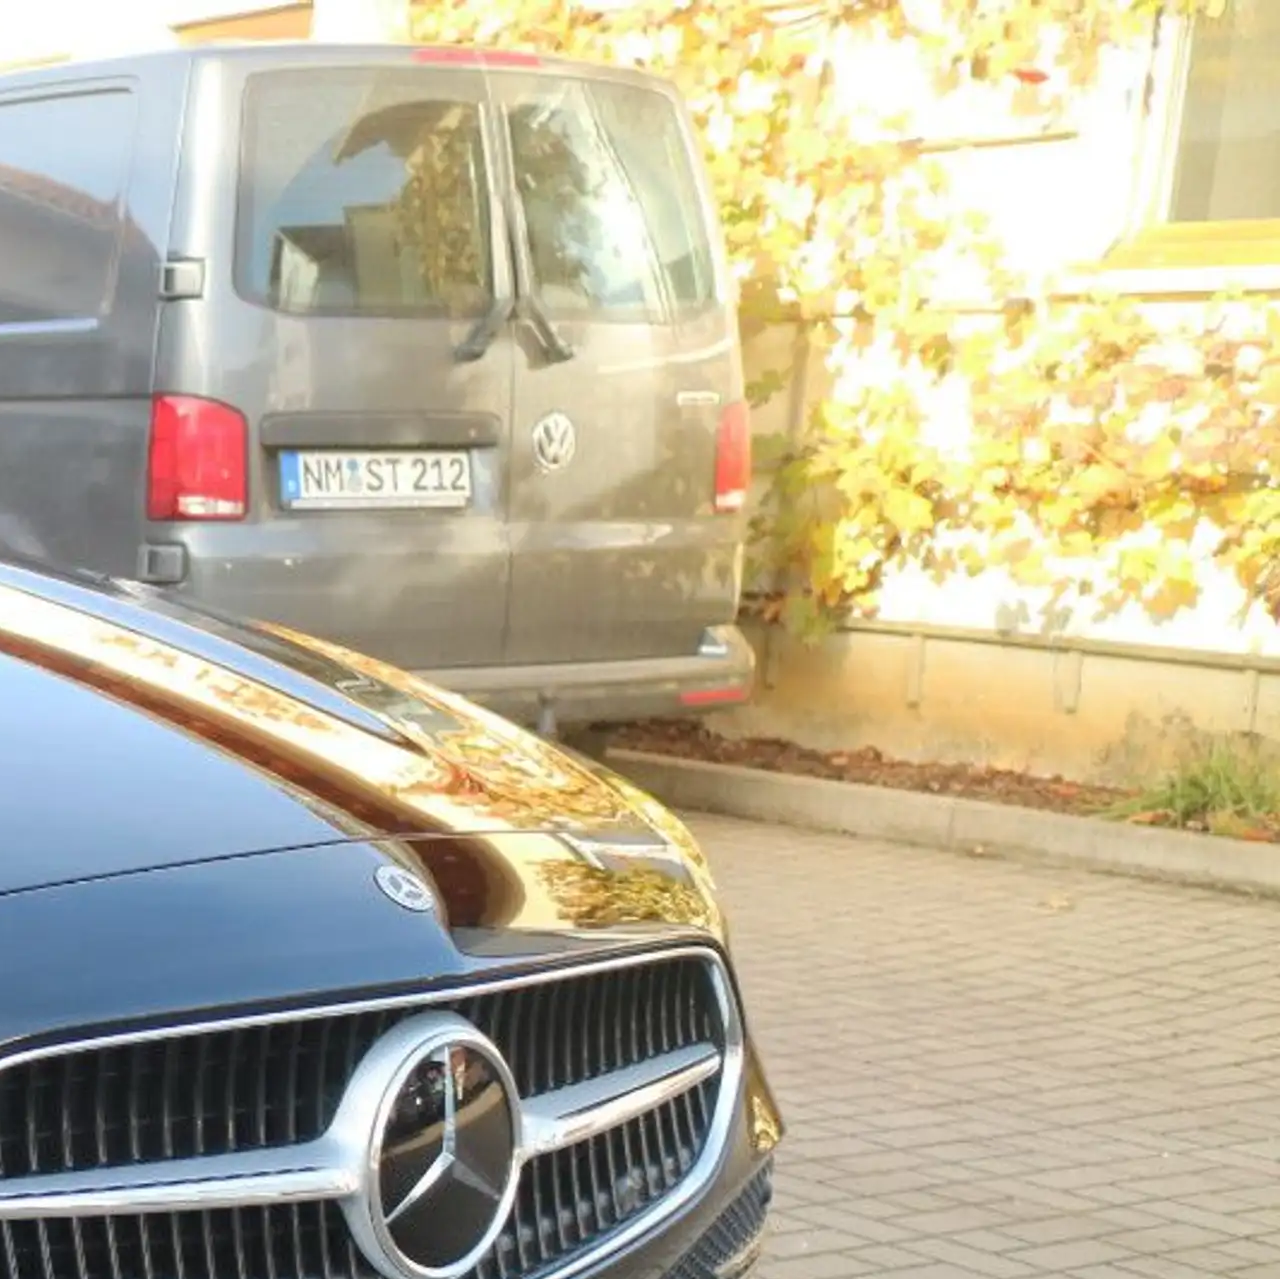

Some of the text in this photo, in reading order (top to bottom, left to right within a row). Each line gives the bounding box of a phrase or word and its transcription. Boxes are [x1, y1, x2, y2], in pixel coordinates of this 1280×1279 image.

[303, 458, 467, 493] NM ST 212
